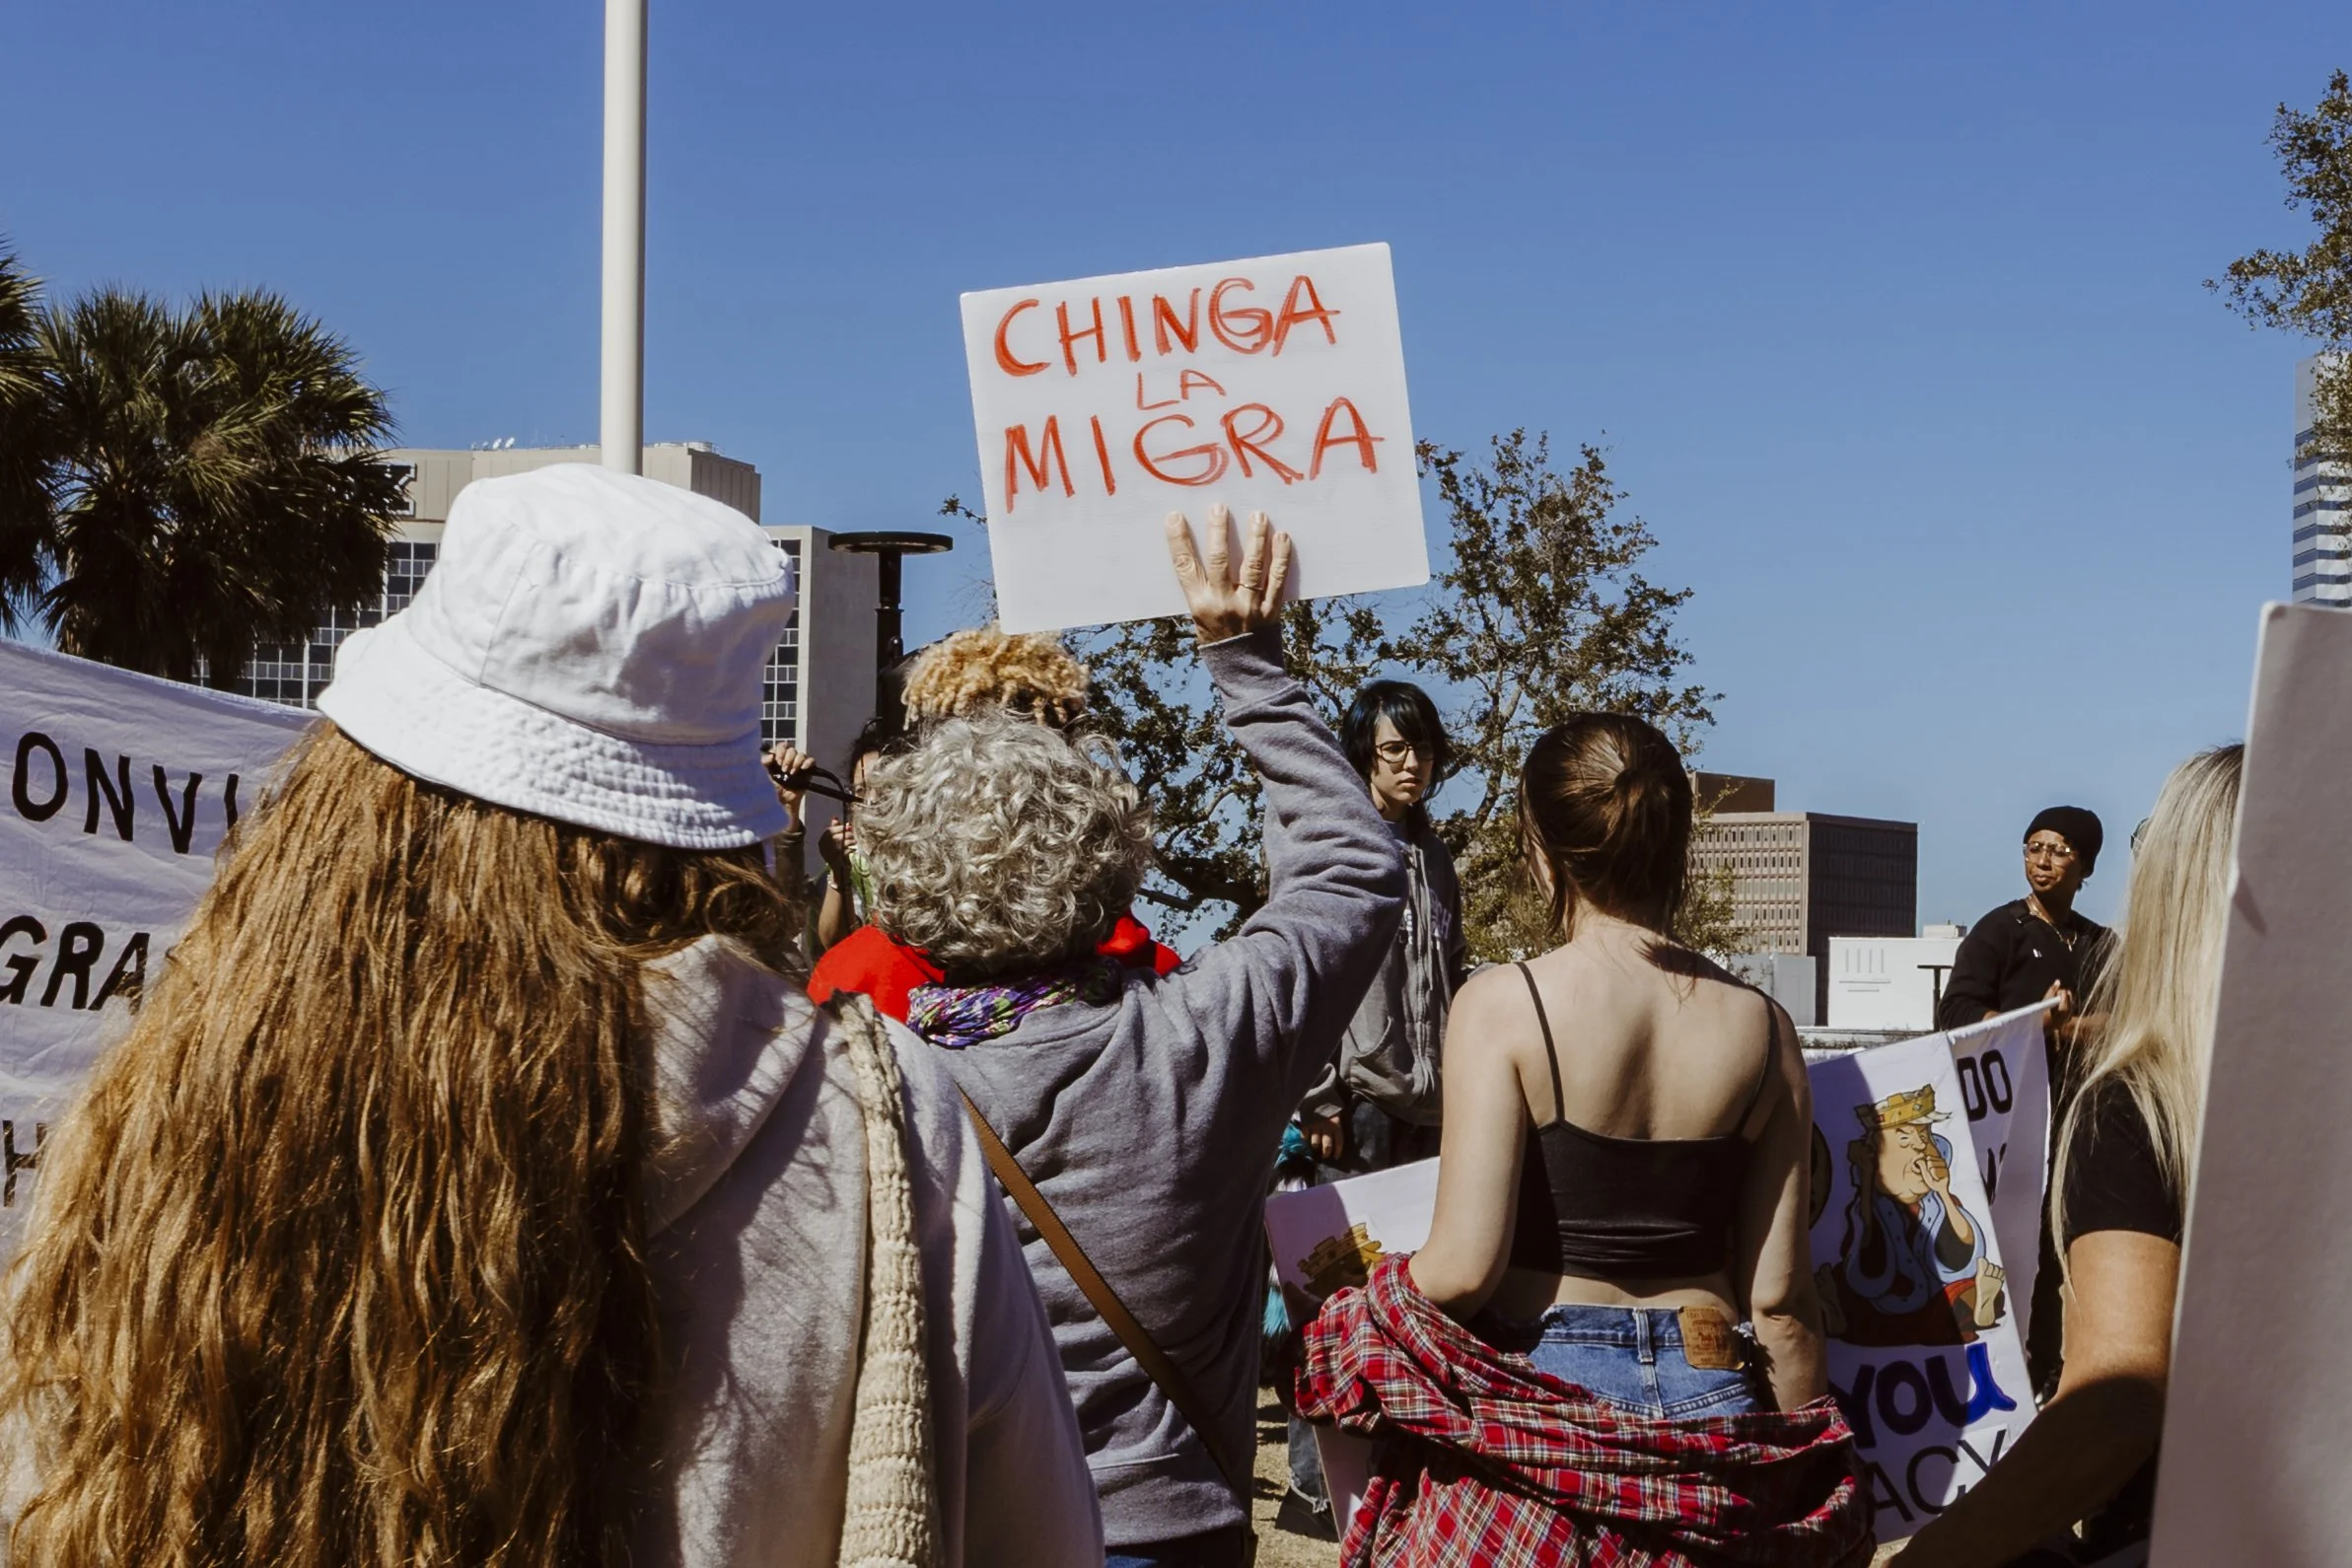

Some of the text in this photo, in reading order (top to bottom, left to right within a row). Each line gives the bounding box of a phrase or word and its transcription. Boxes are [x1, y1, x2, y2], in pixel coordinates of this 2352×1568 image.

[994, 274, 1341, 377] CHINGA
[1137, 369, 1227, 410] LA
[1005, 396, 1385, 514] MIGRA
